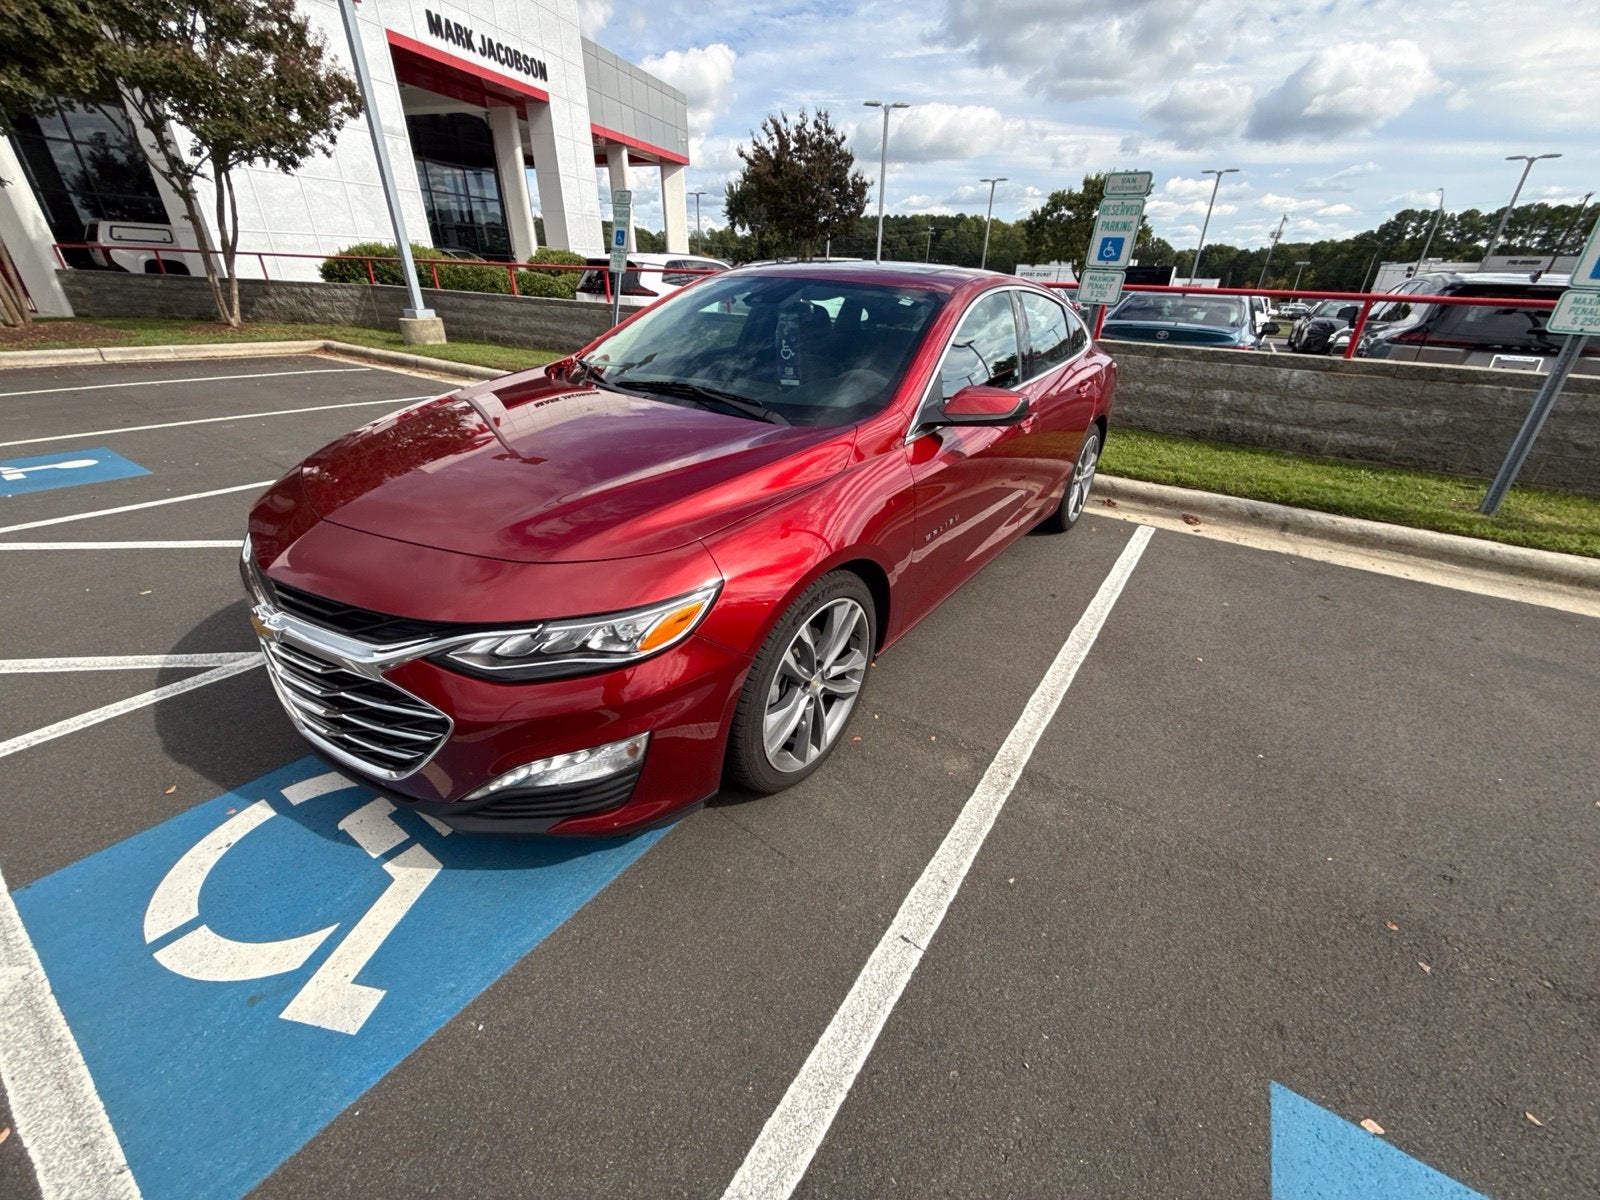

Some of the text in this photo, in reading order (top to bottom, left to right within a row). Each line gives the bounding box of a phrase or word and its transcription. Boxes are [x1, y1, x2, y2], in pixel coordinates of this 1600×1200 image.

[425, 8, 548, 82] MARK JACOBSON
[1121, 177, 1137, 185] VAN
[1101, 204, 1141, 216] RESERVED
[1101, 221, 1134, 232] PARKING
[1089, 275, 1116, 283] MAXIMUM
[1087, 282, 1113, 290] PENALTY
[1568, 307, 1600, 316] PENAL
